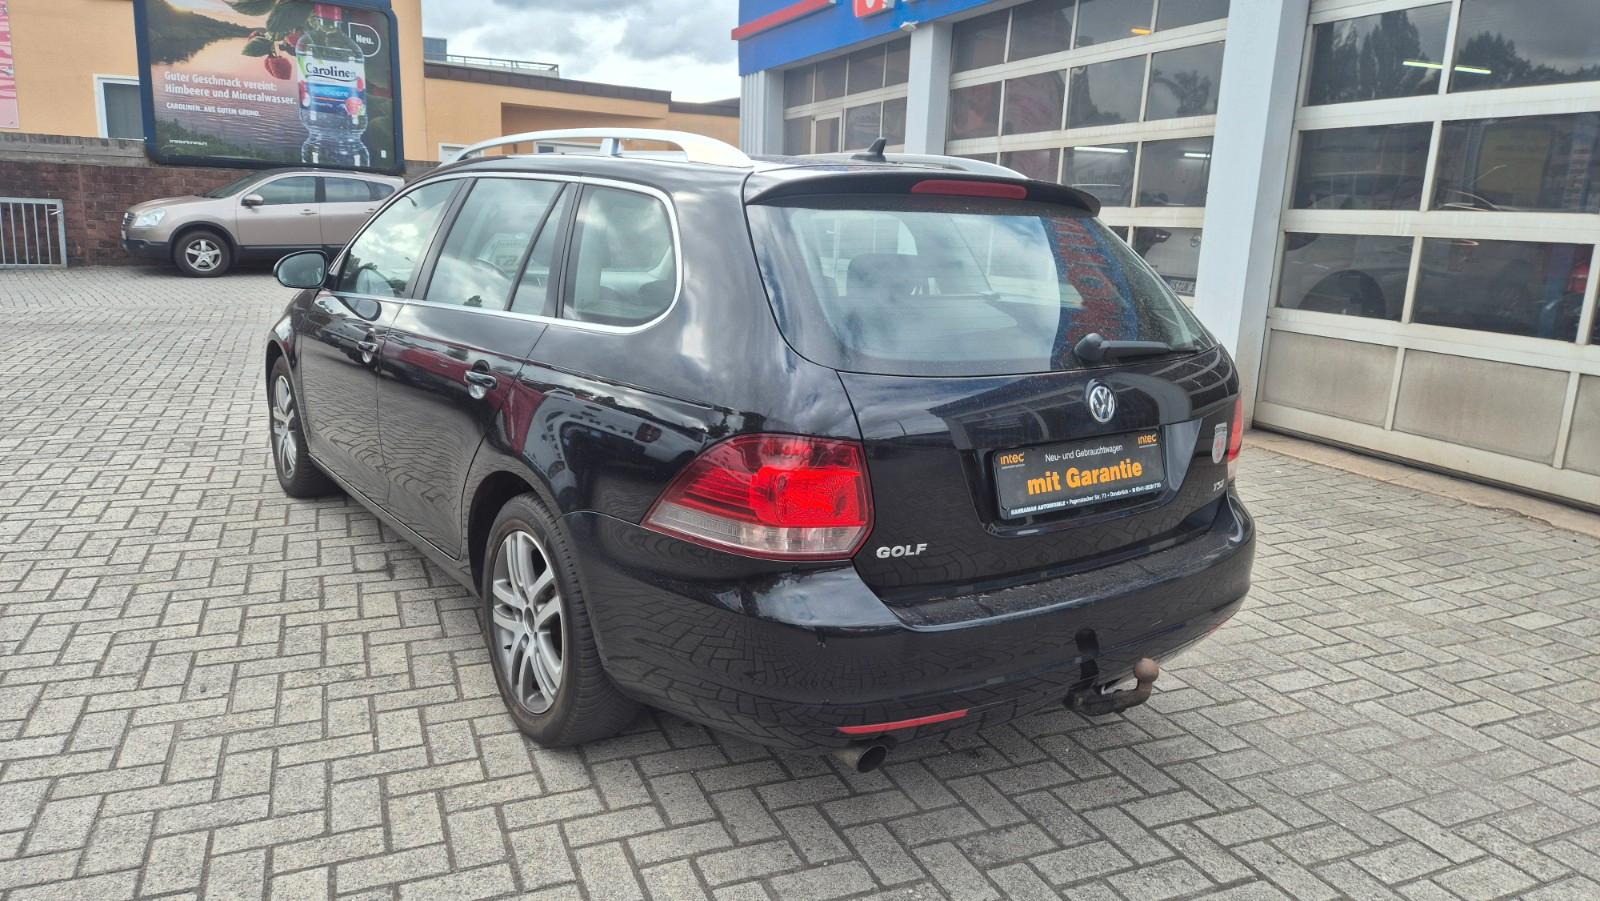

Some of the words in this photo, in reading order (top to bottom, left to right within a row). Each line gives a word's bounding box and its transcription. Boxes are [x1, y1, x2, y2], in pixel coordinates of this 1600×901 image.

[355, 34, 375, 45] Neu.
[306, 62, 357, 80] Carolinen
[164, 71, 190, 82] Guter
[192, 74, 241, 88] Geschmack
[244, 80, 277, 91] vereint:
[165, 83, 210, 97] Himbeere
[212, 90, 230, 99] und
[232, 90, 297, 105] Mineralwasser.
[1137, 433, 1157, 445] intec
[1000, 451, 1025, 465] intec
[1045, 452, 1061, 462] Neu-
[1062, 450, 1075, 460] und
[1075, 444, 1123, 458] Gebrauchtwagen
[1027, 471, 1062, 496] mit
[1066, 458, 1143, 488] Garantie
[876, 543, 928, 559] GOLF
